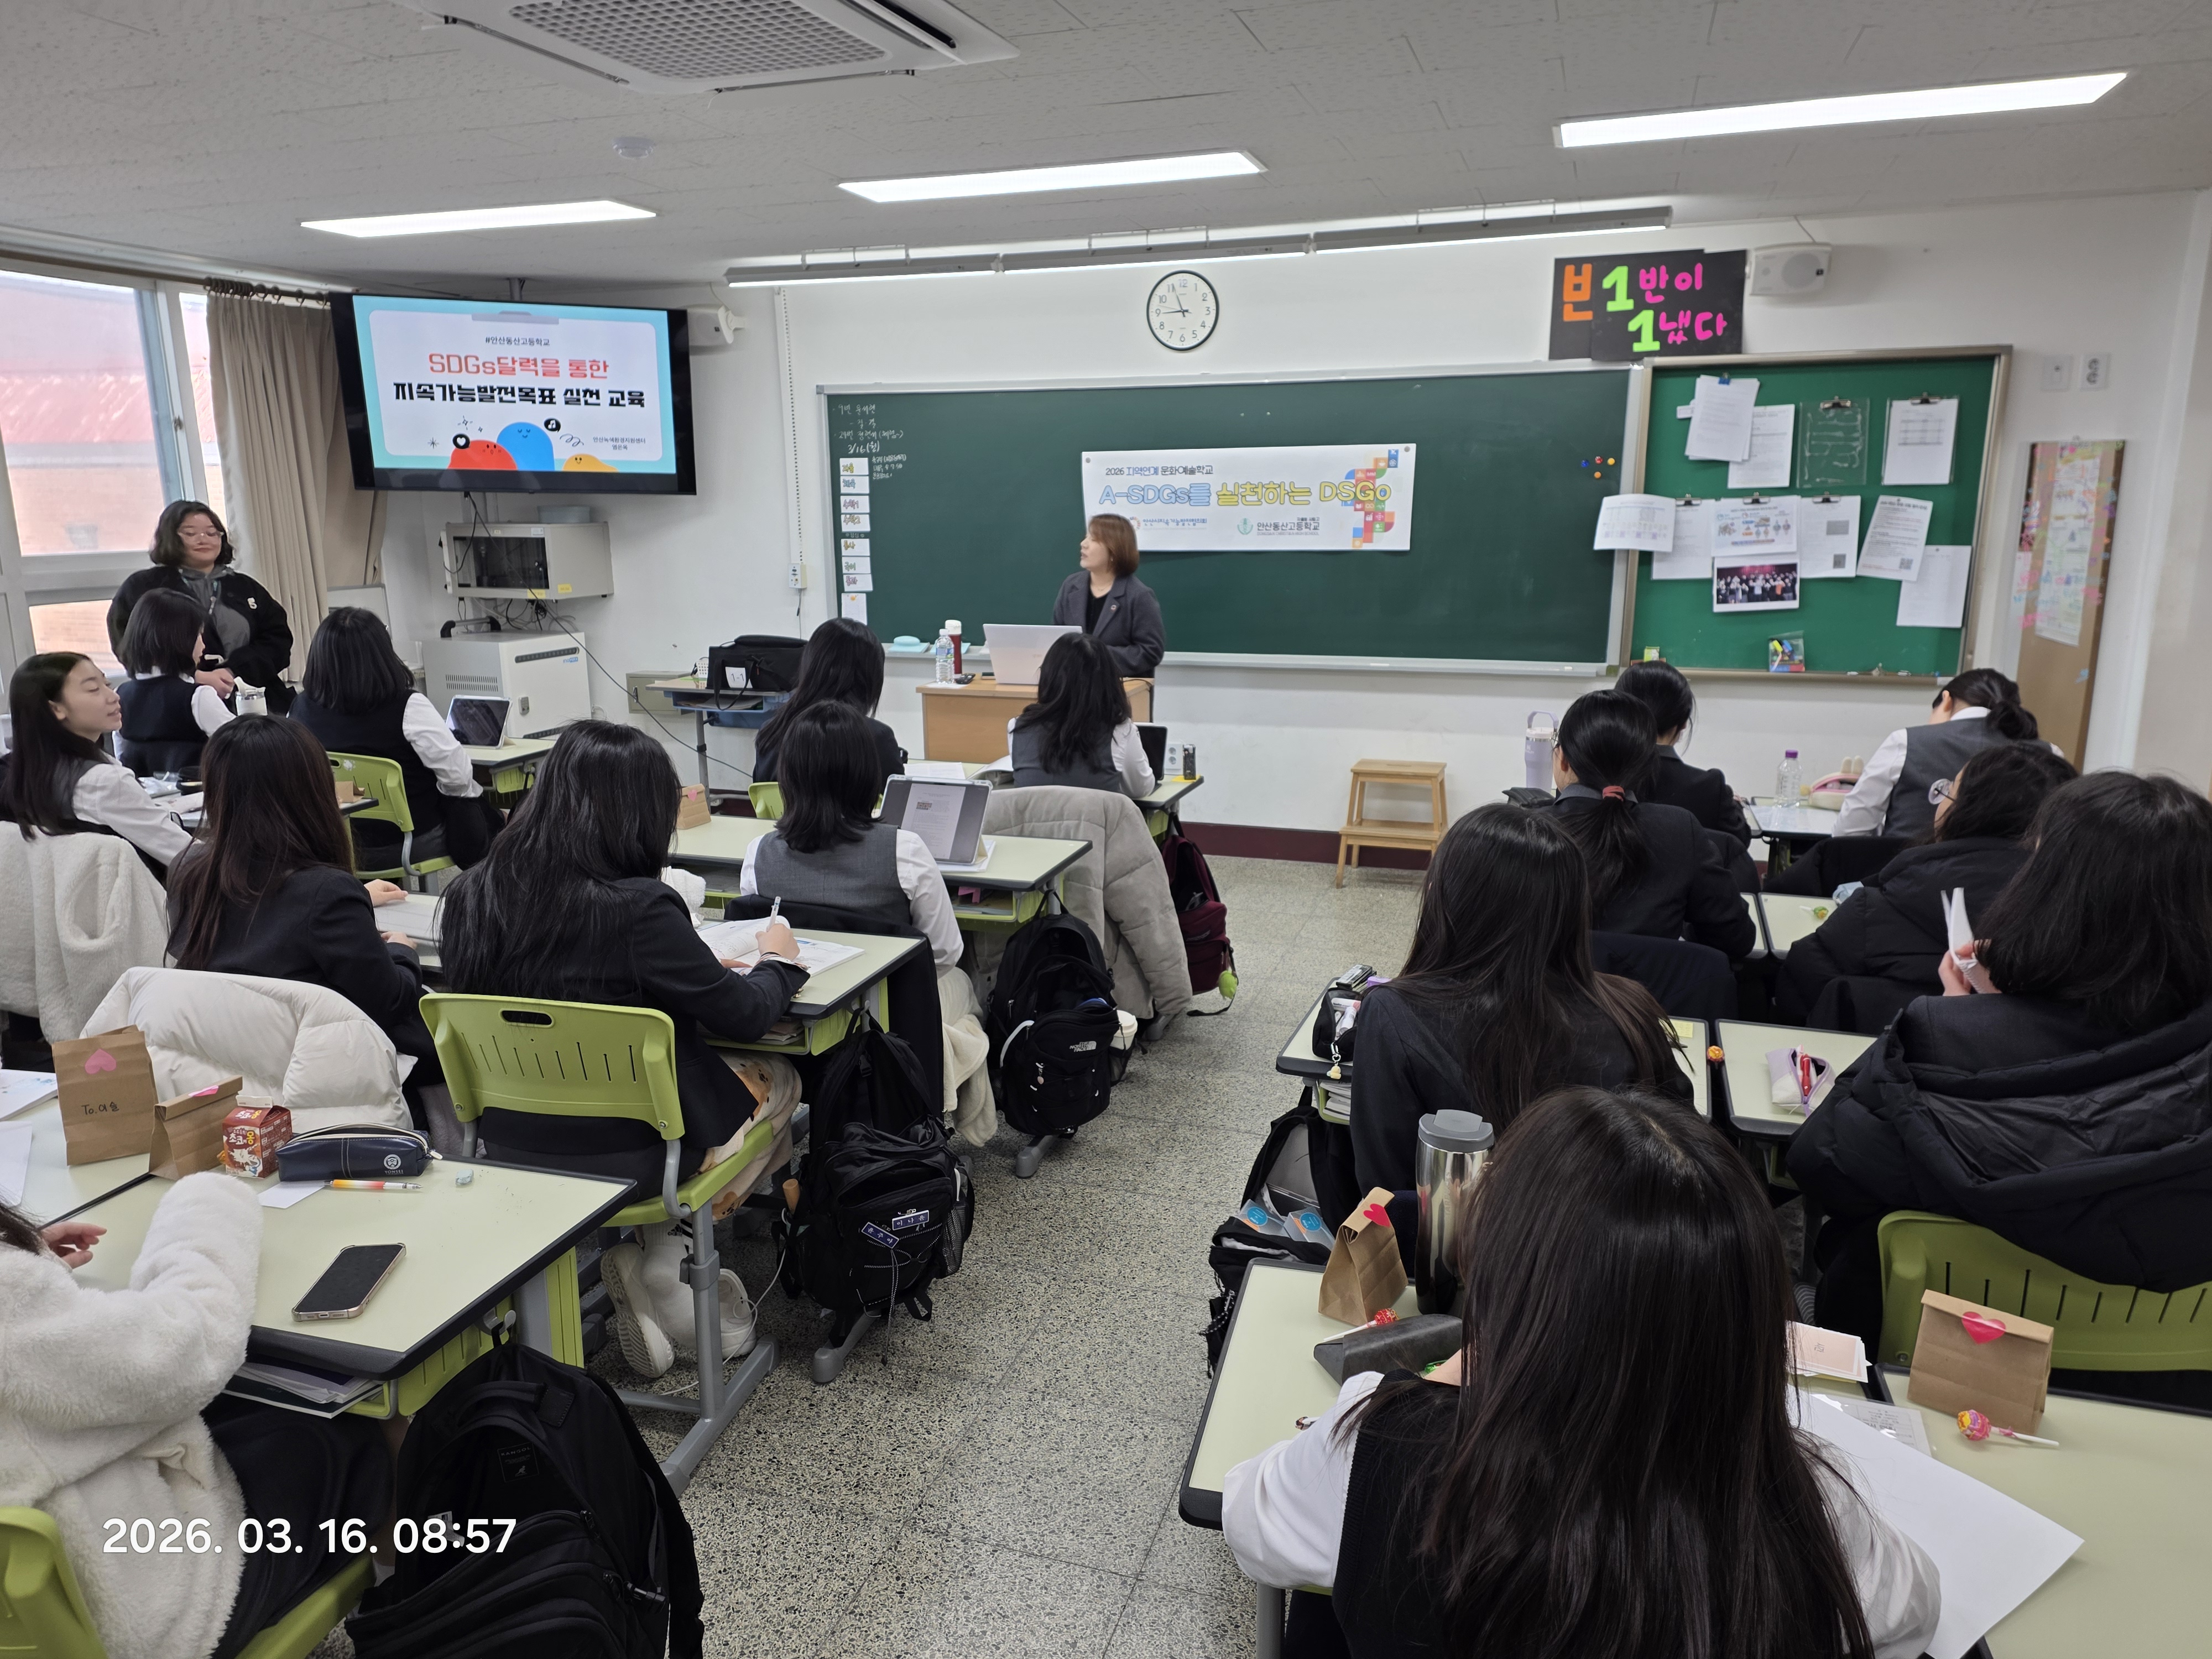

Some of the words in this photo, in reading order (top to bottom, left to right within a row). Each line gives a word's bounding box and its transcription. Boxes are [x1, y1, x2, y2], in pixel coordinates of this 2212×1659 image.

[1178, 279, 1188, 288] 12
[1158, 294, 1167, 304] 10
[1202, 292, 1208, 301] 2
[1155, 308, 1161, 317] 9
[1205, 306, 1211, 315] 3
[1159, 321, 1165, 330] 8
[1200, 320, 1207, 328] 4
[1168, 330, 1173, 339] 7
[1179, 333, 1186, 342] 6
[1192, 330, 1198, 338] 5
[484, 336, 551, 347] #안산동산고등학교
[428, 352, 561, 378] SDGs달력을
[568, 358, 609, 379] 통한
[393, 381, 557, 405] 지속가능발전목표
[563, 388, 601, 406] 실천
[608, 389, 646, 408] 교육
[592, 436, 646, 444] 안산녹색환경지원센터
[1105, 467, 1125, 476] 2026
[1125, 466, 1160, 477] 지역연계
[842, 478, 856, 489] 체육
[1099, 482, 1212, 507] A-SDGs를
[1215, 481, 1312, 507] 실천하는
[1319, 481, 1392, 503] DSGo
[1256, 521, 1320, 531] 안산동산고등학교
[844, 561, 856, 571] 국어
[731, 673, 744, 682] 1-1
[500, 1446, 531, 1456] KANGOL
